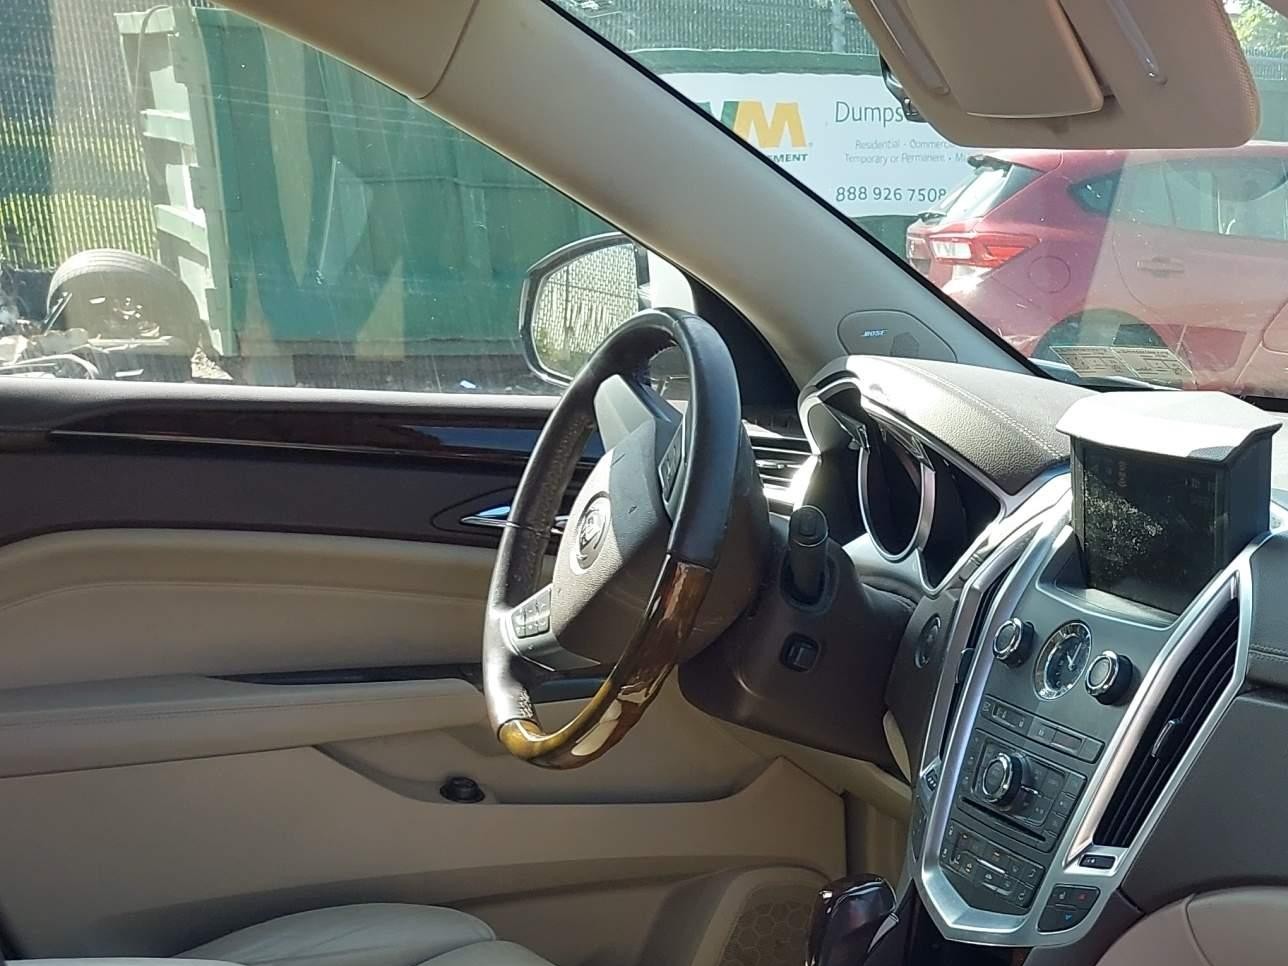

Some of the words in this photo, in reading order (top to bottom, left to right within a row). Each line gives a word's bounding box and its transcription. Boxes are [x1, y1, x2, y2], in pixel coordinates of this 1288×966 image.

[845, 153, 888, 166] Temporary
[901, 153, 945, 163] Permanent
[835, 186, 868, 202] 888
[872, 187, 903, 201] 926
